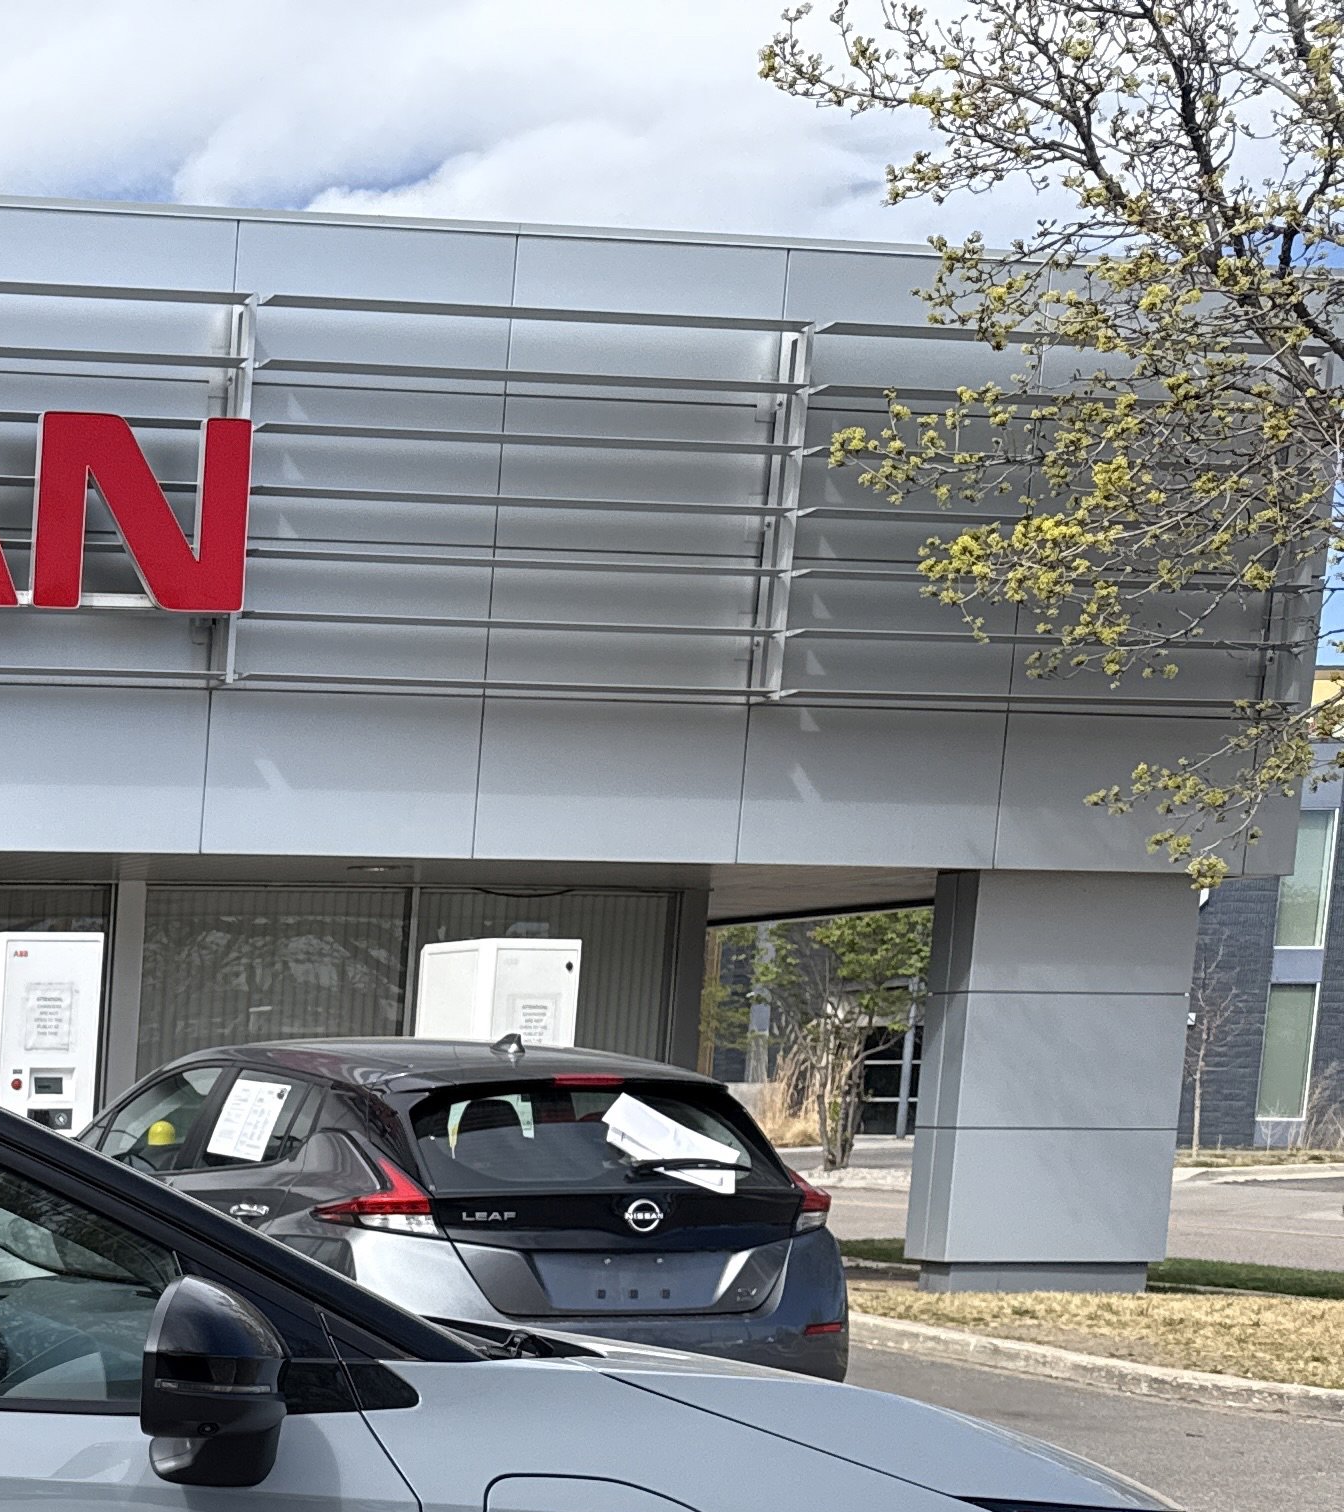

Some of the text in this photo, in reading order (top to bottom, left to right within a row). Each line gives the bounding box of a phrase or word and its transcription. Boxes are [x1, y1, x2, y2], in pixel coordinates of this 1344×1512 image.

[13, 950, 29, 958] ABB
[462, 1211, 516, 1221] LEAF
[624, 1212, 664, 1220] NISSAN
